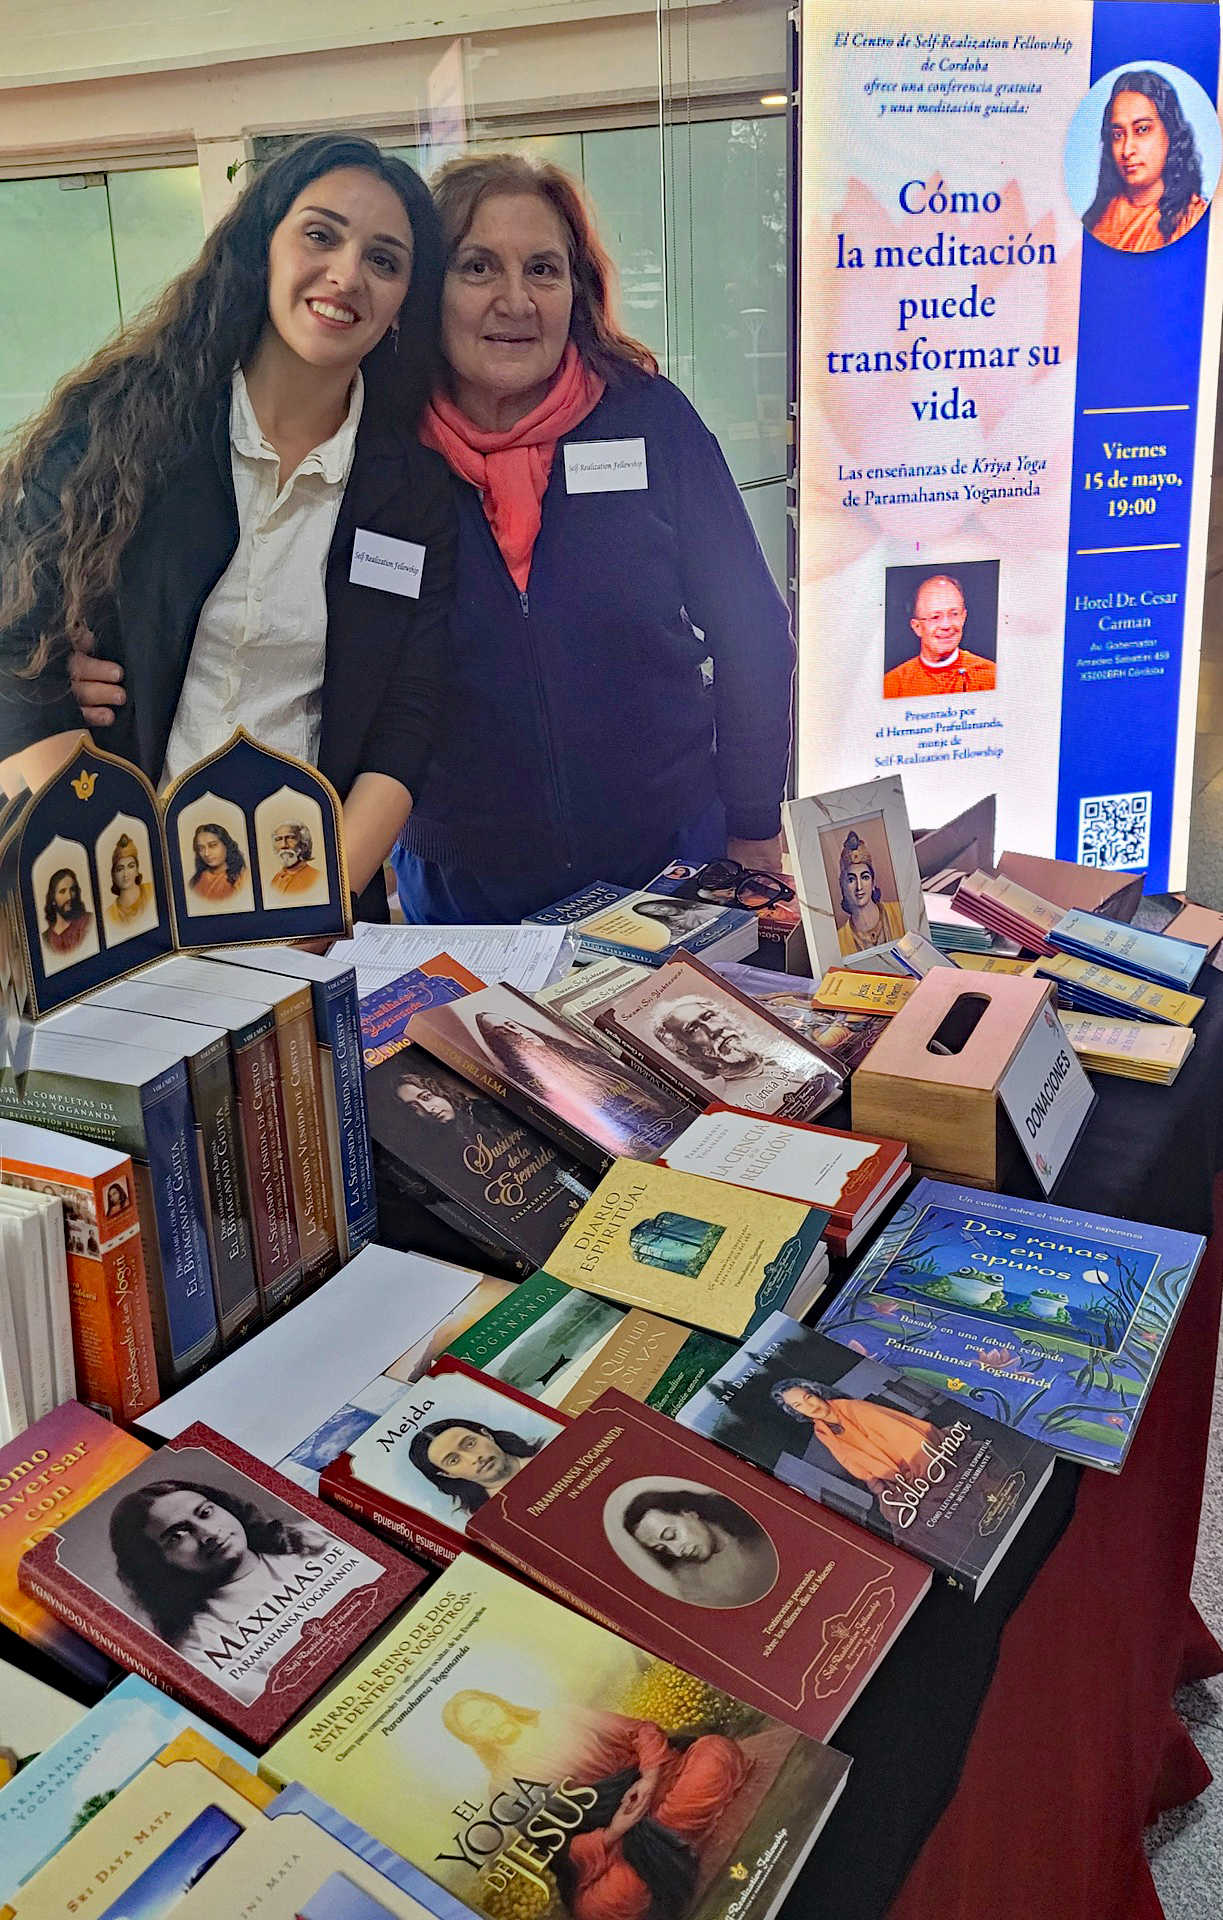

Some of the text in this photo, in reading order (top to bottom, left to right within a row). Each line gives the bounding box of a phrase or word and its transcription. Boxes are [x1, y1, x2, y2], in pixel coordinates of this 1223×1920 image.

[834, 32, 1073, 54] El Centro de Self-Realization Fellowship
[921, 57, 989, 72] de Cordoba
[864, 77, 1042, 97] ofrece una conferencia gratuita
[878, 100, 1030, 118] y una meditación guiada:
[899, 179, 1001, 214] Cómo
[836, 232, 1057, 269] la meditación
[898, 284, 996, 331] puede
[827, 337, 1061, 374] transformar su
[911, 386, 978, 421] vida
[568, 460, 643, 473] Self-Realization Fellowship
[838, 455, 1047, 480] Las enseñanzas de Kriya Yoga
[1102, 441, 1167, 459] Viernes
[842, 480, 1041, 507] de Paramahansa Yogananda
[1084, 470, 1183, 491] 15 de mayo,
[1108, 497, 1157, 517] 19:00
[354, 551, 419, 576] Self-Realization Fellowship
[1074, 591, 1178, 611] Hotel Dr. Cesar
[1098, 615, 1152, 631] Carman
[875, 727, 884, 738] el
[887, 726, 933, 738] Hermano
[905, 706, 977, 721] Presentado por
[875, 746, 1004, 768] Self-Realization Fellowship
[918, 735, 962, 750] monje de
[536, 886, 610, 922] EL AMANTE
[621, 967, 684, 1023] Swami Sri Yukteswar
[34, 1090, 115, 1111] COMPLETAS DE
[462, 1060, 508, 1098] DEL ALMA
[1025, 1049, 1071, 1140] DONACIONES
[51, 1102, 118, 1122] YOGANANDA
[65, 1121, 116, 1137] FELLOWSHIP
[216, 1107, 228, 1156] GUITA
[336, 1013, 360, 1207] LA SEGUNDA VENIDA DE CRISTO
[171, 1141, 184, 1192] GUITA
[251, 1062, 281, 1264] LA SEGUNDA VENIDA DE CRISTO
[710, 1123, 771, 1177] LA CIENCIA
[739, 1130, 795, 1181] RELIGIÓN
[221, 1159, 238, 1237] BHAGAVAD
[958, 1194, 1143, 1240] Un cuento sobre el valor y la esperanza
[178, 1195, 196, 1275] BHAGAVAD
[574, 1191, 621, 1251] DIARIO
[580, 1183, 648, 1272] ESPIRITUAL
[961, 1219, 1110, 1262] Dos ranas
[229, 1237, 240, 1260] EL
[970, 1250, 1072, 1282] apuros
[1009, 1246, 1043, 1261] en
[186, 1273, 199, 1298] EL
[112, 1254, 144, 1408] Autobiografía de un Yogui
[460, 1286, 557, 1363] YOGANANDA
[899, 1314, 938, 1331] Basado
[940, 1325, 954, 1336] en
[957, 1330, 979, 1342] una
[980, 1332, 1018, 1351] fábula
[601, 1319, 649, 1378] QUIETUD
[884, 1337, 1052, 1390] Paramahansa Yogananda
[964, 1342, 985, 1354] por
[652, 1371, 685, 1412] Cómo cultivar
[671, 1367, 706, 1417] relación amorosa
[716, 1341, 782, 1408] SRI DAYA MATA
[376, 1398, 435, 1453] Mejda
[0, 1440, 89, 1520] nversar
[526, 1425, 625, 1517] PARAMAHANSA YOGANANDA
[567, 1456, 614, 1500] IN MEMÓRIAM
[881, 1419, 972, 1529] Sólo Amor
[24, 1484, 72, 1523] con
[203, 1546, 346, 1672] MÁXIMAS DE
[228, 1558, 360, 1681] PARAMAHANSA YOGANANDA
[762, 1569, 817, 1635] Testimonios personales
[357, 1679, 375, 1693] EL
[371, 1640, 411, 1679] REINO
[409, 1622, 430, 1641] DE
[425, 1591, 457, 1622] DIOS
[313, 1724, 348, 1753] ESTÁ
[343, 1674, 396, 1725] DENTRO
[394, 1657, 414, 1676] DE
[381, 1645, 471, 1737] Paramahansa Yogananda
[1, 1732, 100, 1822] PARAMAHANSA
[16, 1746, 102, 1822] YOGANANDA
[434, 1775, 553, 1873] YOGA
[450, 1798, 485, 1825] EL
[484, 1775, 599, 1901] DE JESÚS
[66, 1810, 172, 1914] SRI DAYA MATA
